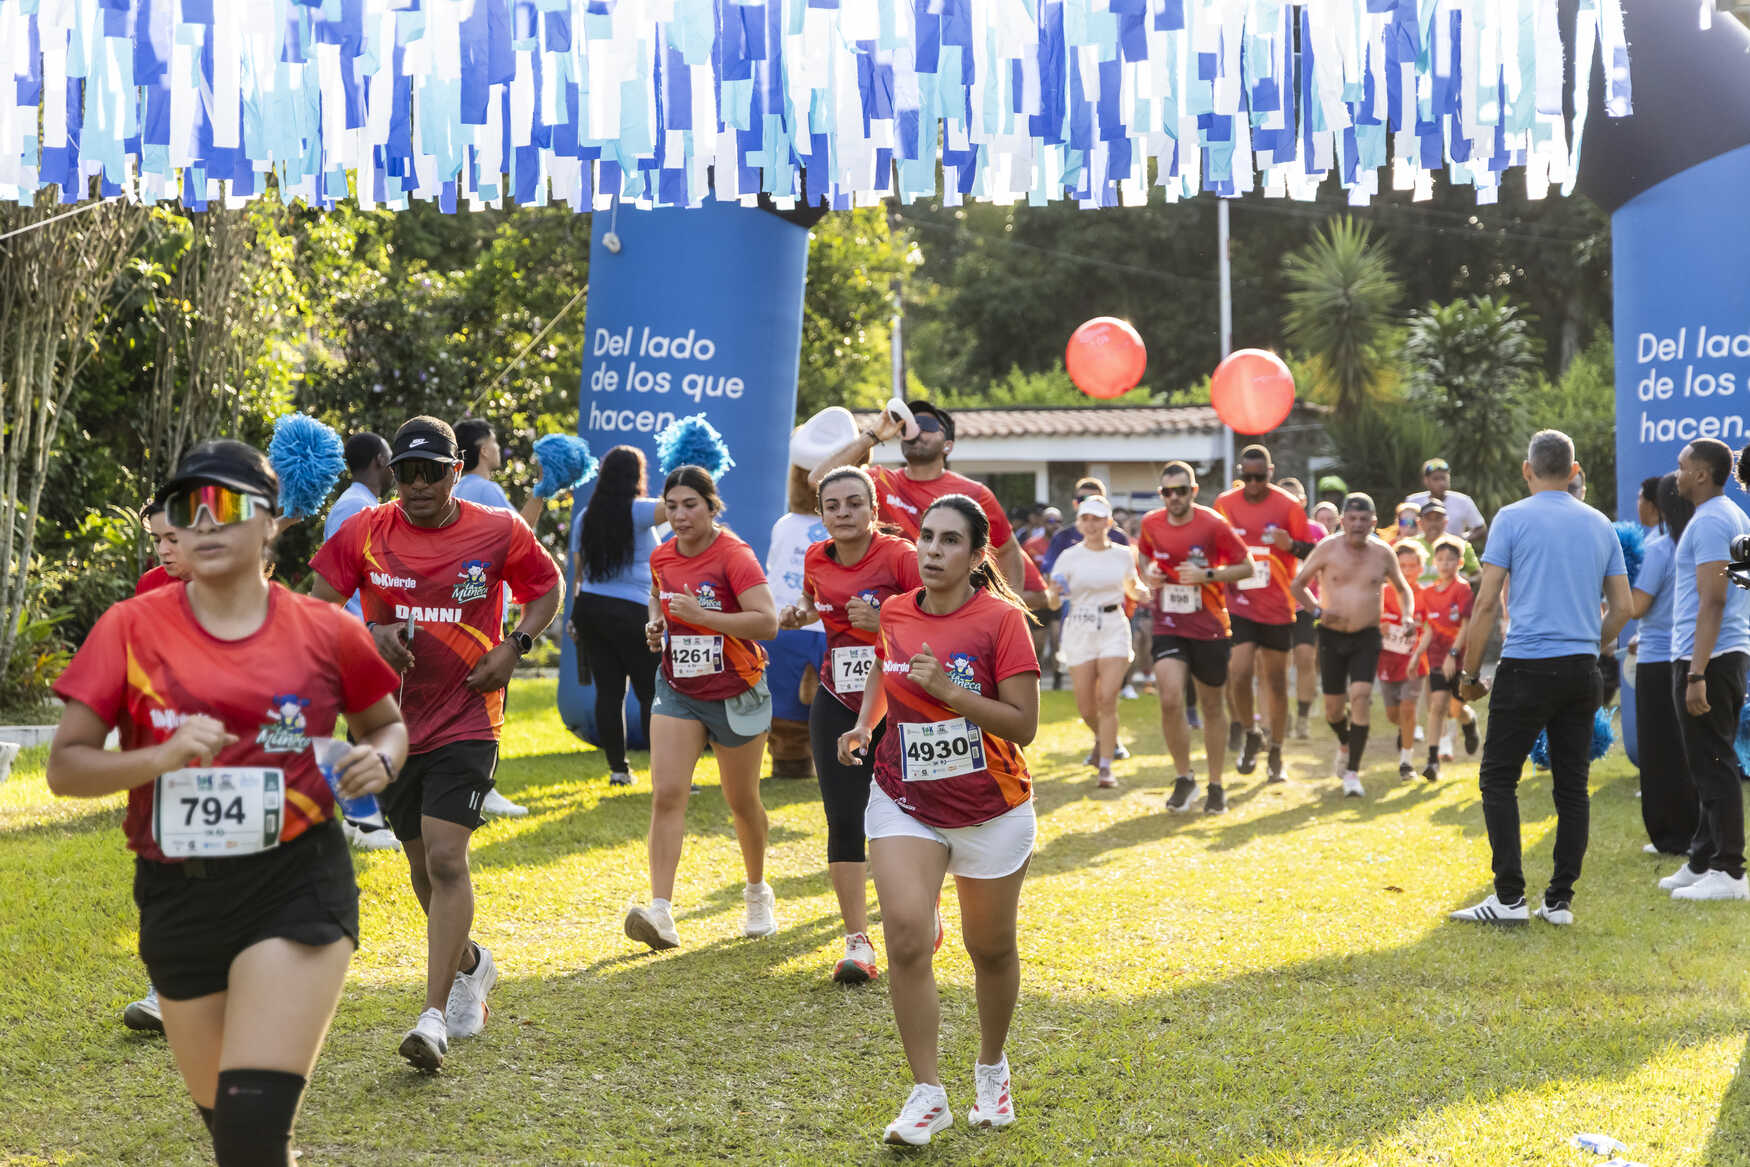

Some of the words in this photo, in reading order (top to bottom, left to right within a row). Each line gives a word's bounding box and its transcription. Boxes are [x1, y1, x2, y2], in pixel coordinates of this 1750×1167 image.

[593, 325, 634, 357] Del
[639, 326, 716, 361] lado
[1638, 327, 1687, 364] Del
[590, 361, 619, 392] de
[625, 361, 672, 393] los
[681, 373, 745, 403] que
[1638, 368, 1675, 402] de
[1684, 365, 1737, 398] los
[395, 604, 462, 623] DANNI
[907, 736, 969, 762] 4930
[180, 796, 246, 827] 794
